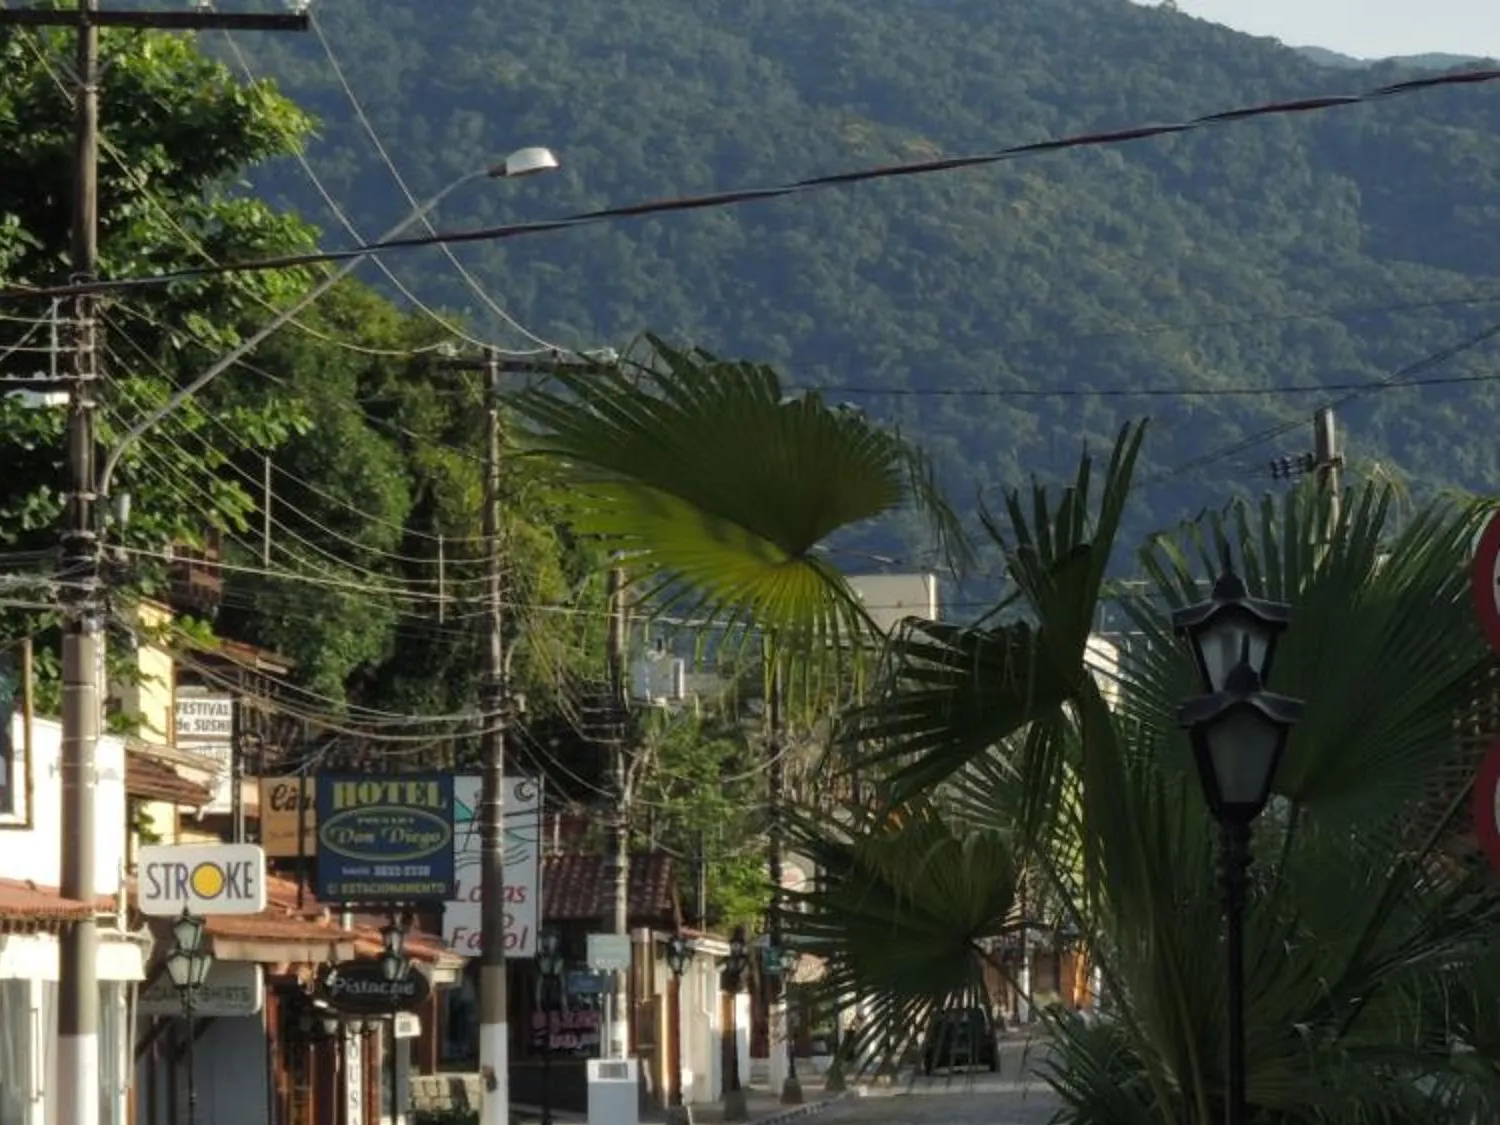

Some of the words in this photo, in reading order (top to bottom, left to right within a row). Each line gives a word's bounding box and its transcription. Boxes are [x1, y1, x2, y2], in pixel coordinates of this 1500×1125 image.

[176, 702, 231, 716] FESTIVAL
[194, 719, 231, 732] SUSHI
[332, 780, 447, 810] HOTEL
[329, 826, 375, 844] Don
[145, 861, 255, 901] STROKE
[341, 881, 446, 895] ESTACIONAMENTO
[455, 880, 528, 904] Loas
[451, 925, 529, 950] Faol
